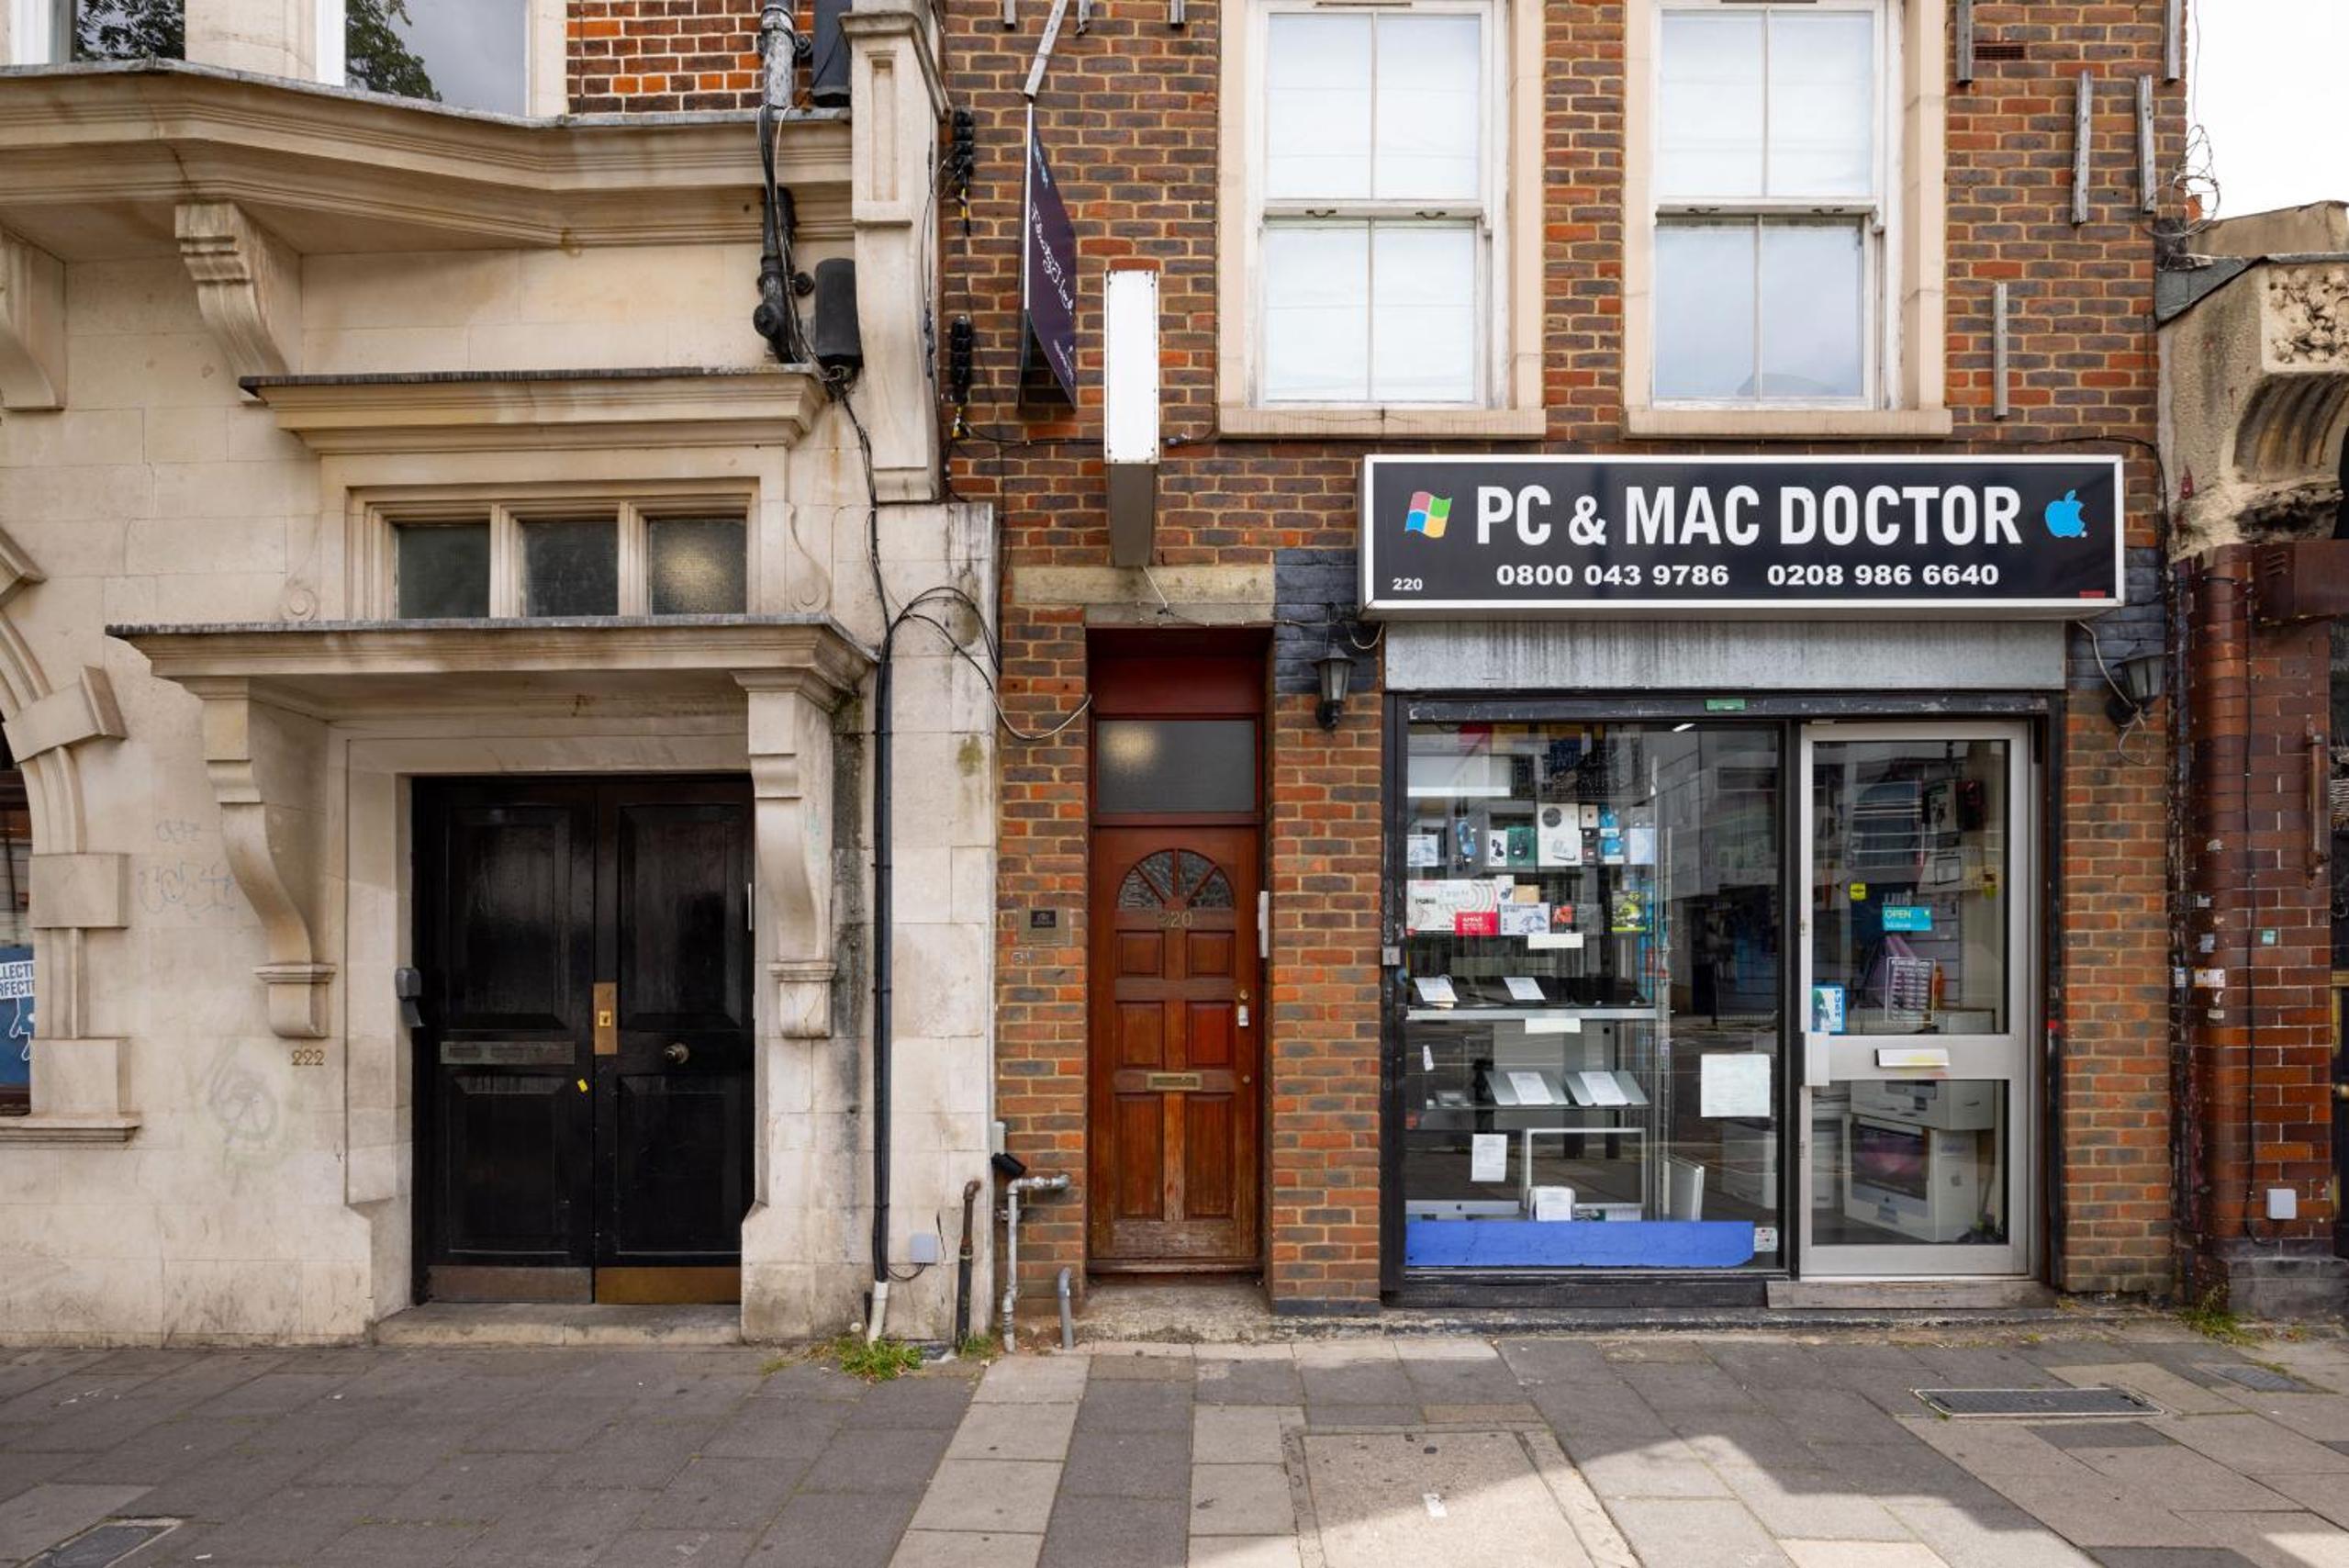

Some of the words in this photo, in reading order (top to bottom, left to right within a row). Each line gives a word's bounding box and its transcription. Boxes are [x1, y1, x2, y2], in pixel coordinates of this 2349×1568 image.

[1477, 485, 1551, 545] PC
[1569, 495, 1606, 546] &
[1626, 485, 1760, 546] MAC
[1780, 485, 2022, 546] DOCTOR
[1393, 577, 1424, 591] 220
[1496, 565, 1573, 586] 0800
[1584, 565, 1641, 586] 043
[1652, 565, 1729, 586] 9786
[1767, 565, 1844, 586] 0208
[1854, 565, 1912, 586] 986
[1922, 564, 1999, 586] 6640
[291, 1049, 324, 1066] 222
